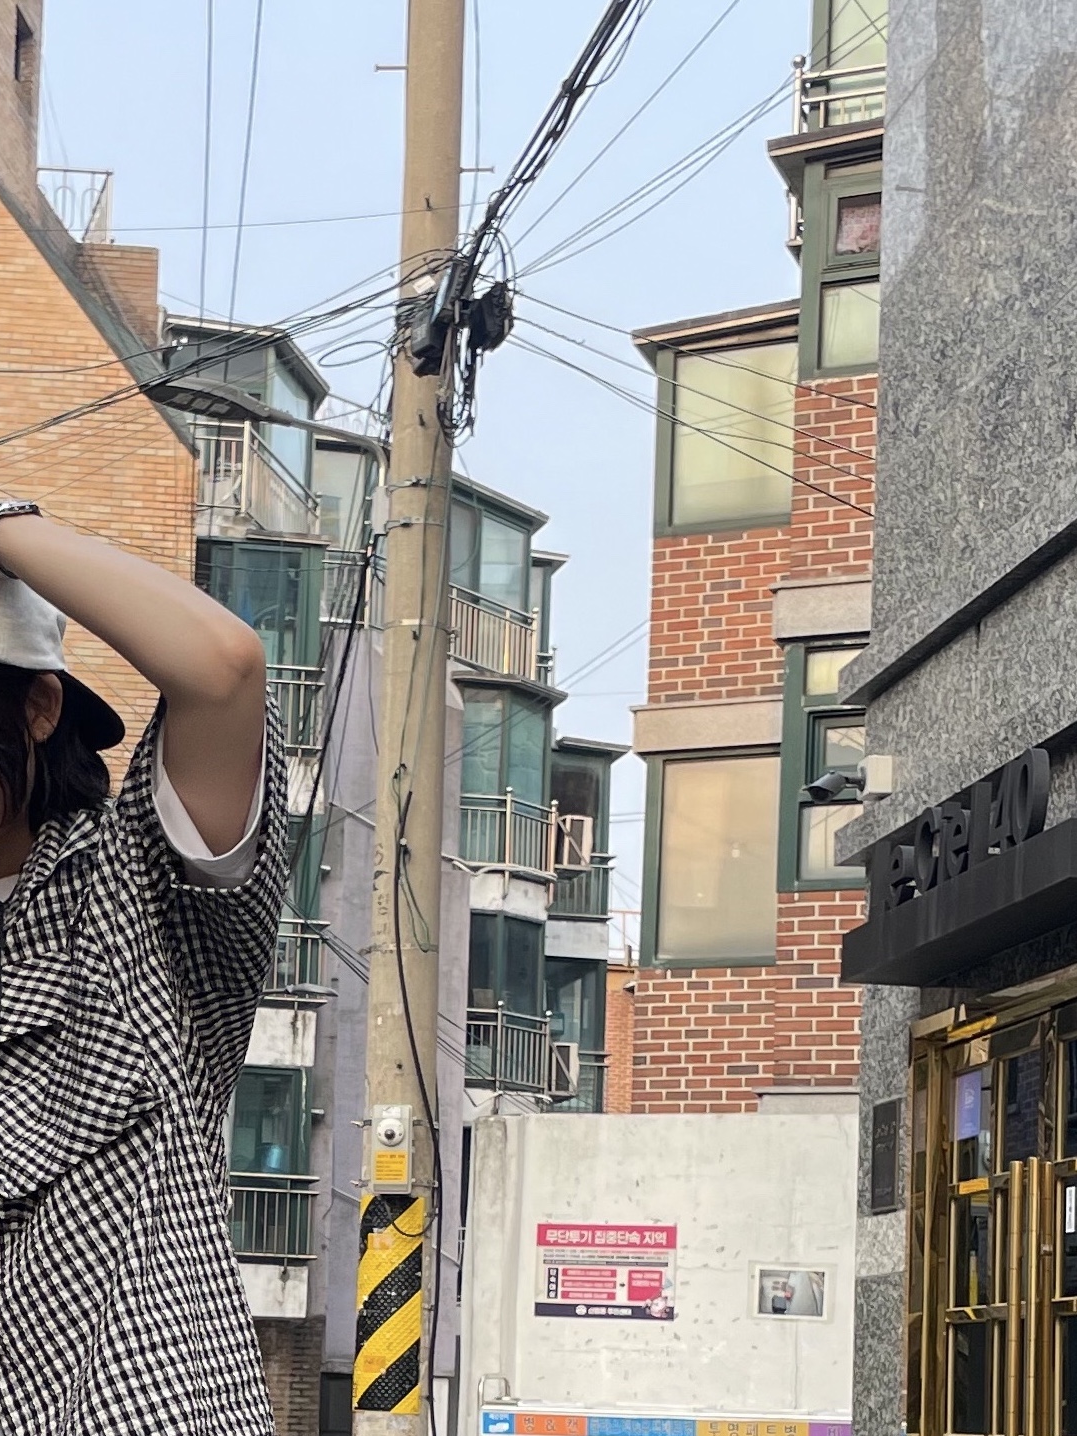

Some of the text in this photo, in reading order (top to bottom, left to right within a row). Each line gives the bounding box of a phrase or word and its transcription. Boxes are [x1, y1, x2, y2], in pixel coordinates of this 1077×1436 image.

[545, 1229, 668, 1246] 무단투기 집중단속 지역
